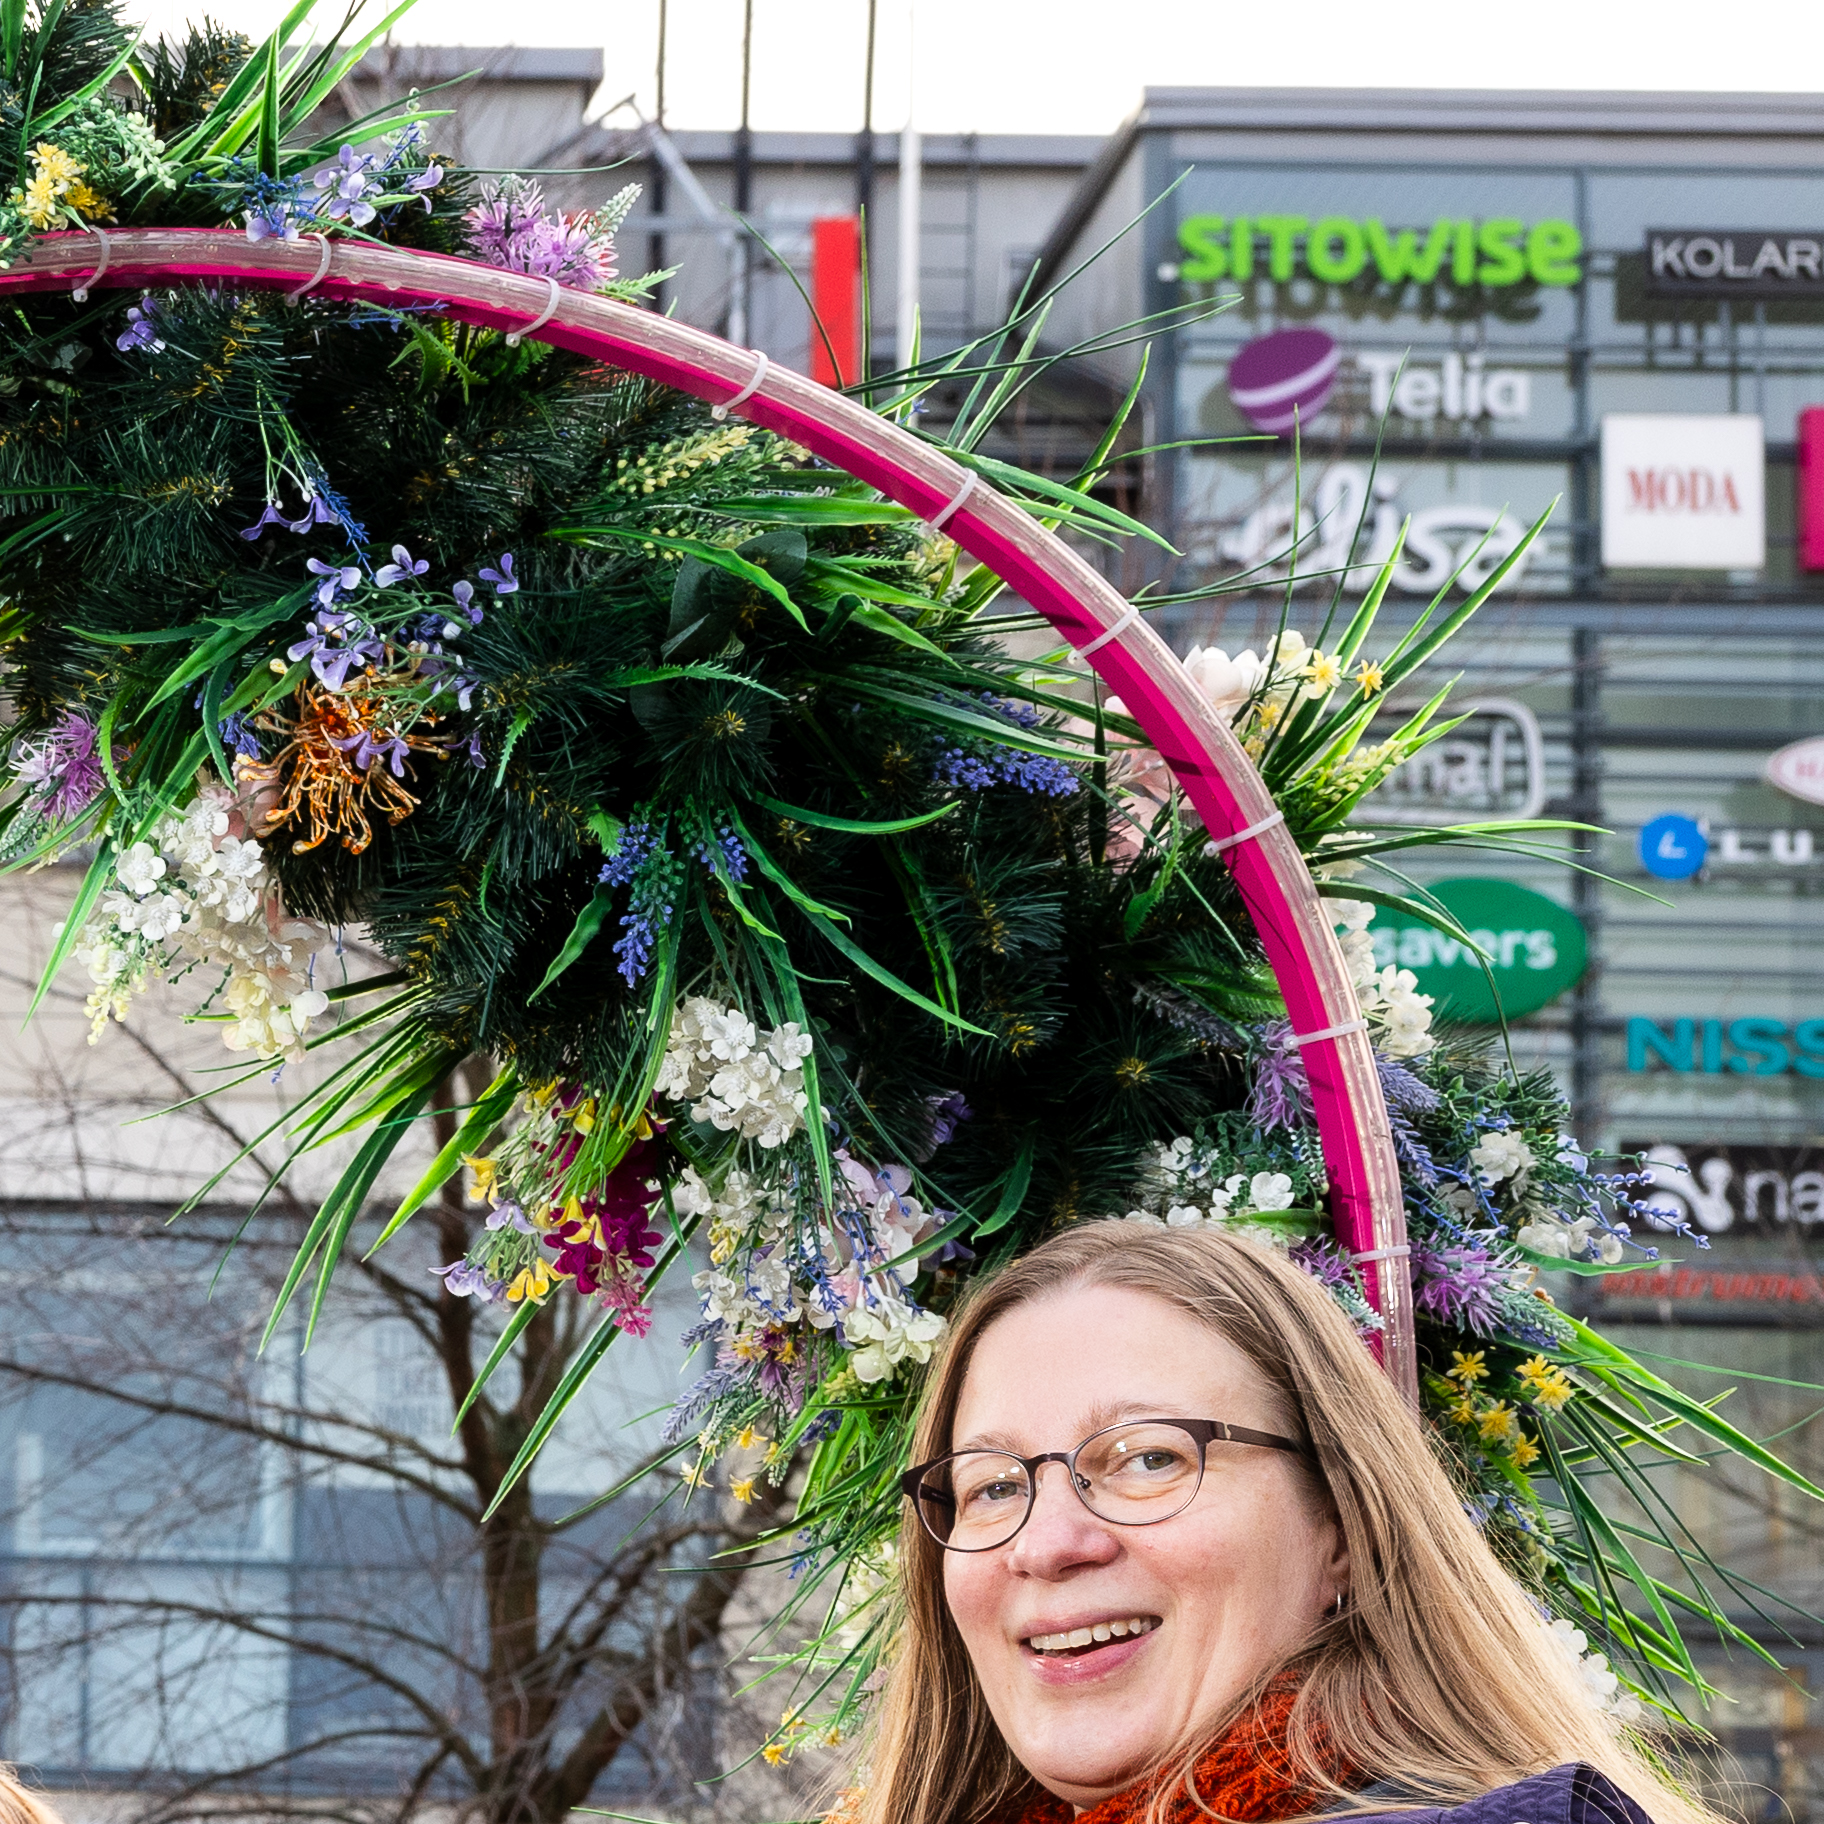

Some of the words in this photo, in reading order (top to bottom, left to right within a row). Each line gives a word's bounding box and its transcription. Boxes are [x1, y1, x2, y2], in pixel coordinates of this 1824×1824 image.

[1652, 237, 1824, 279] KOLAR
[1356, 351, 1532, 420] Telia
[1625, 466, 1742, 516] MODA
[1218, 465, 1550, 593] elisa
